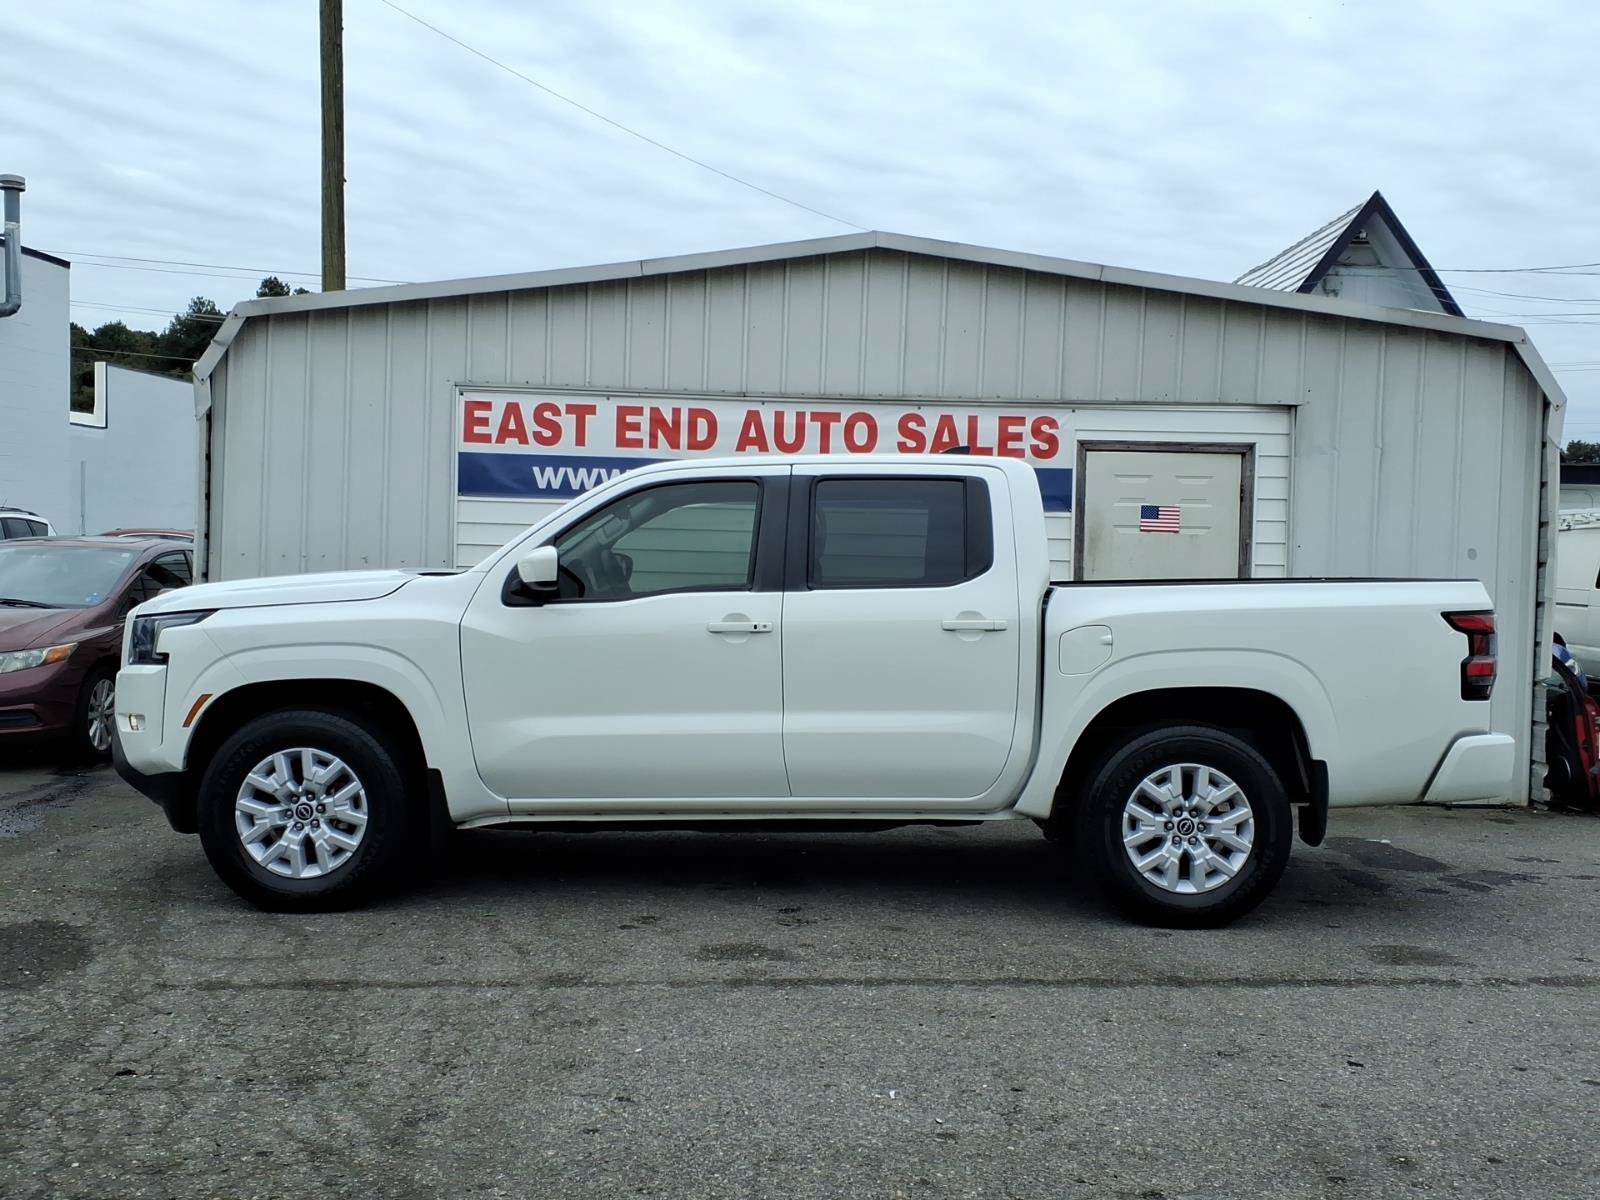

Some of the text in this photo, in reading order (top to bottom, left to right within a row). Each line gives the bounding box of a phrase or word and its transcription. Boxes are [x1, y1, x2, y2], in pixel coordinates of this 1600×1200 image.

[463, 400, 1060, 459] EAST END AUTO SALES
